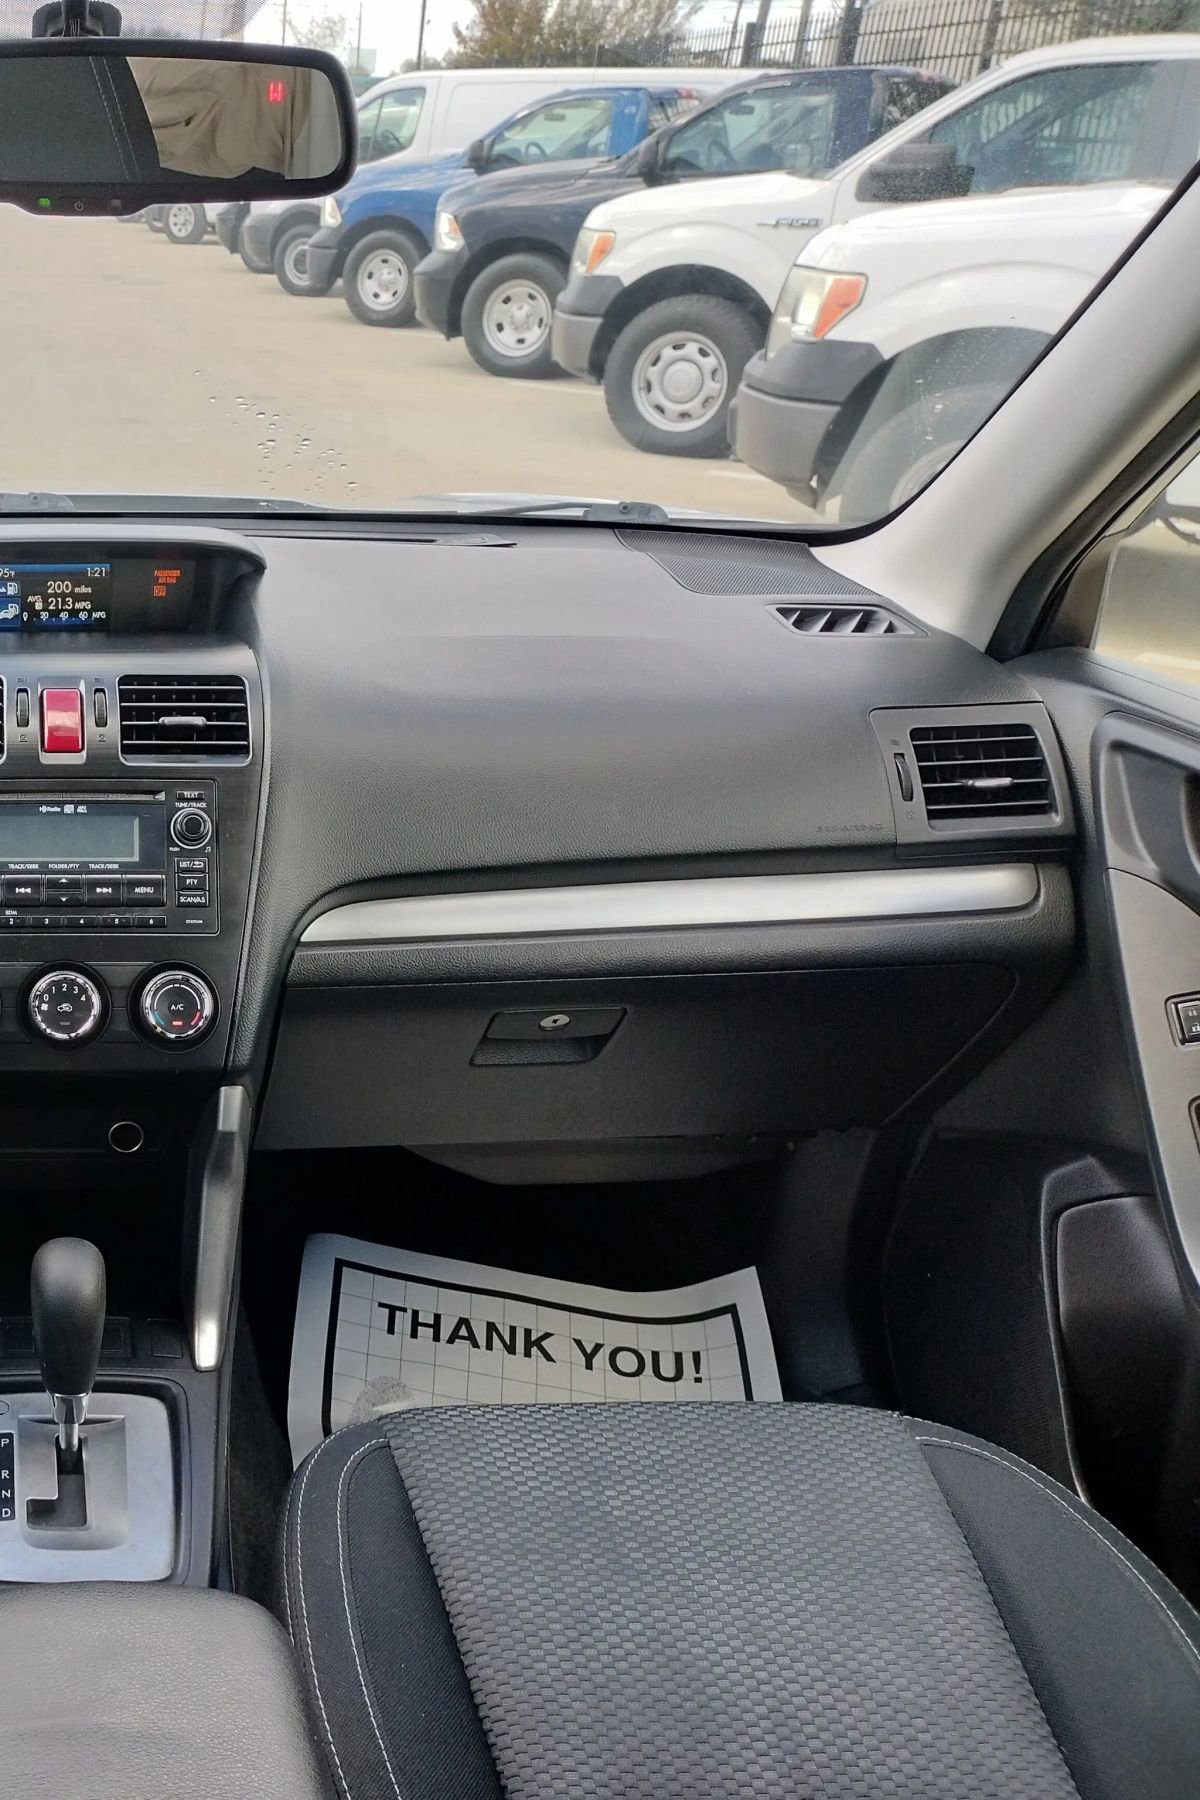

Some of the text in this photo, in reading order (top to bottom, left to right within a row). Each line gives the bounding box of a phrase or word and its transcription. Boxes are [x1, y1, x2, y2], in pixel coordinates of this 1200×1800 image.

[86, 567, 106, 577] 1:21
[47, 581, 92, 593] 200 miles
[48, 598, 91, 610] 21.3 MPG
[134, 886, 154, 894] MENU
[62, 984, 68, 992] 2
[73, 986, 79, 994] 3
[170, 1003, 185, 1011] A/C
[377, 1301, 703, 1384] THANK YOU!
[1, 1438, 10, 1448] P
[1, 1469, 10, 1479] R
[2, 1489, 11, 1499] N
